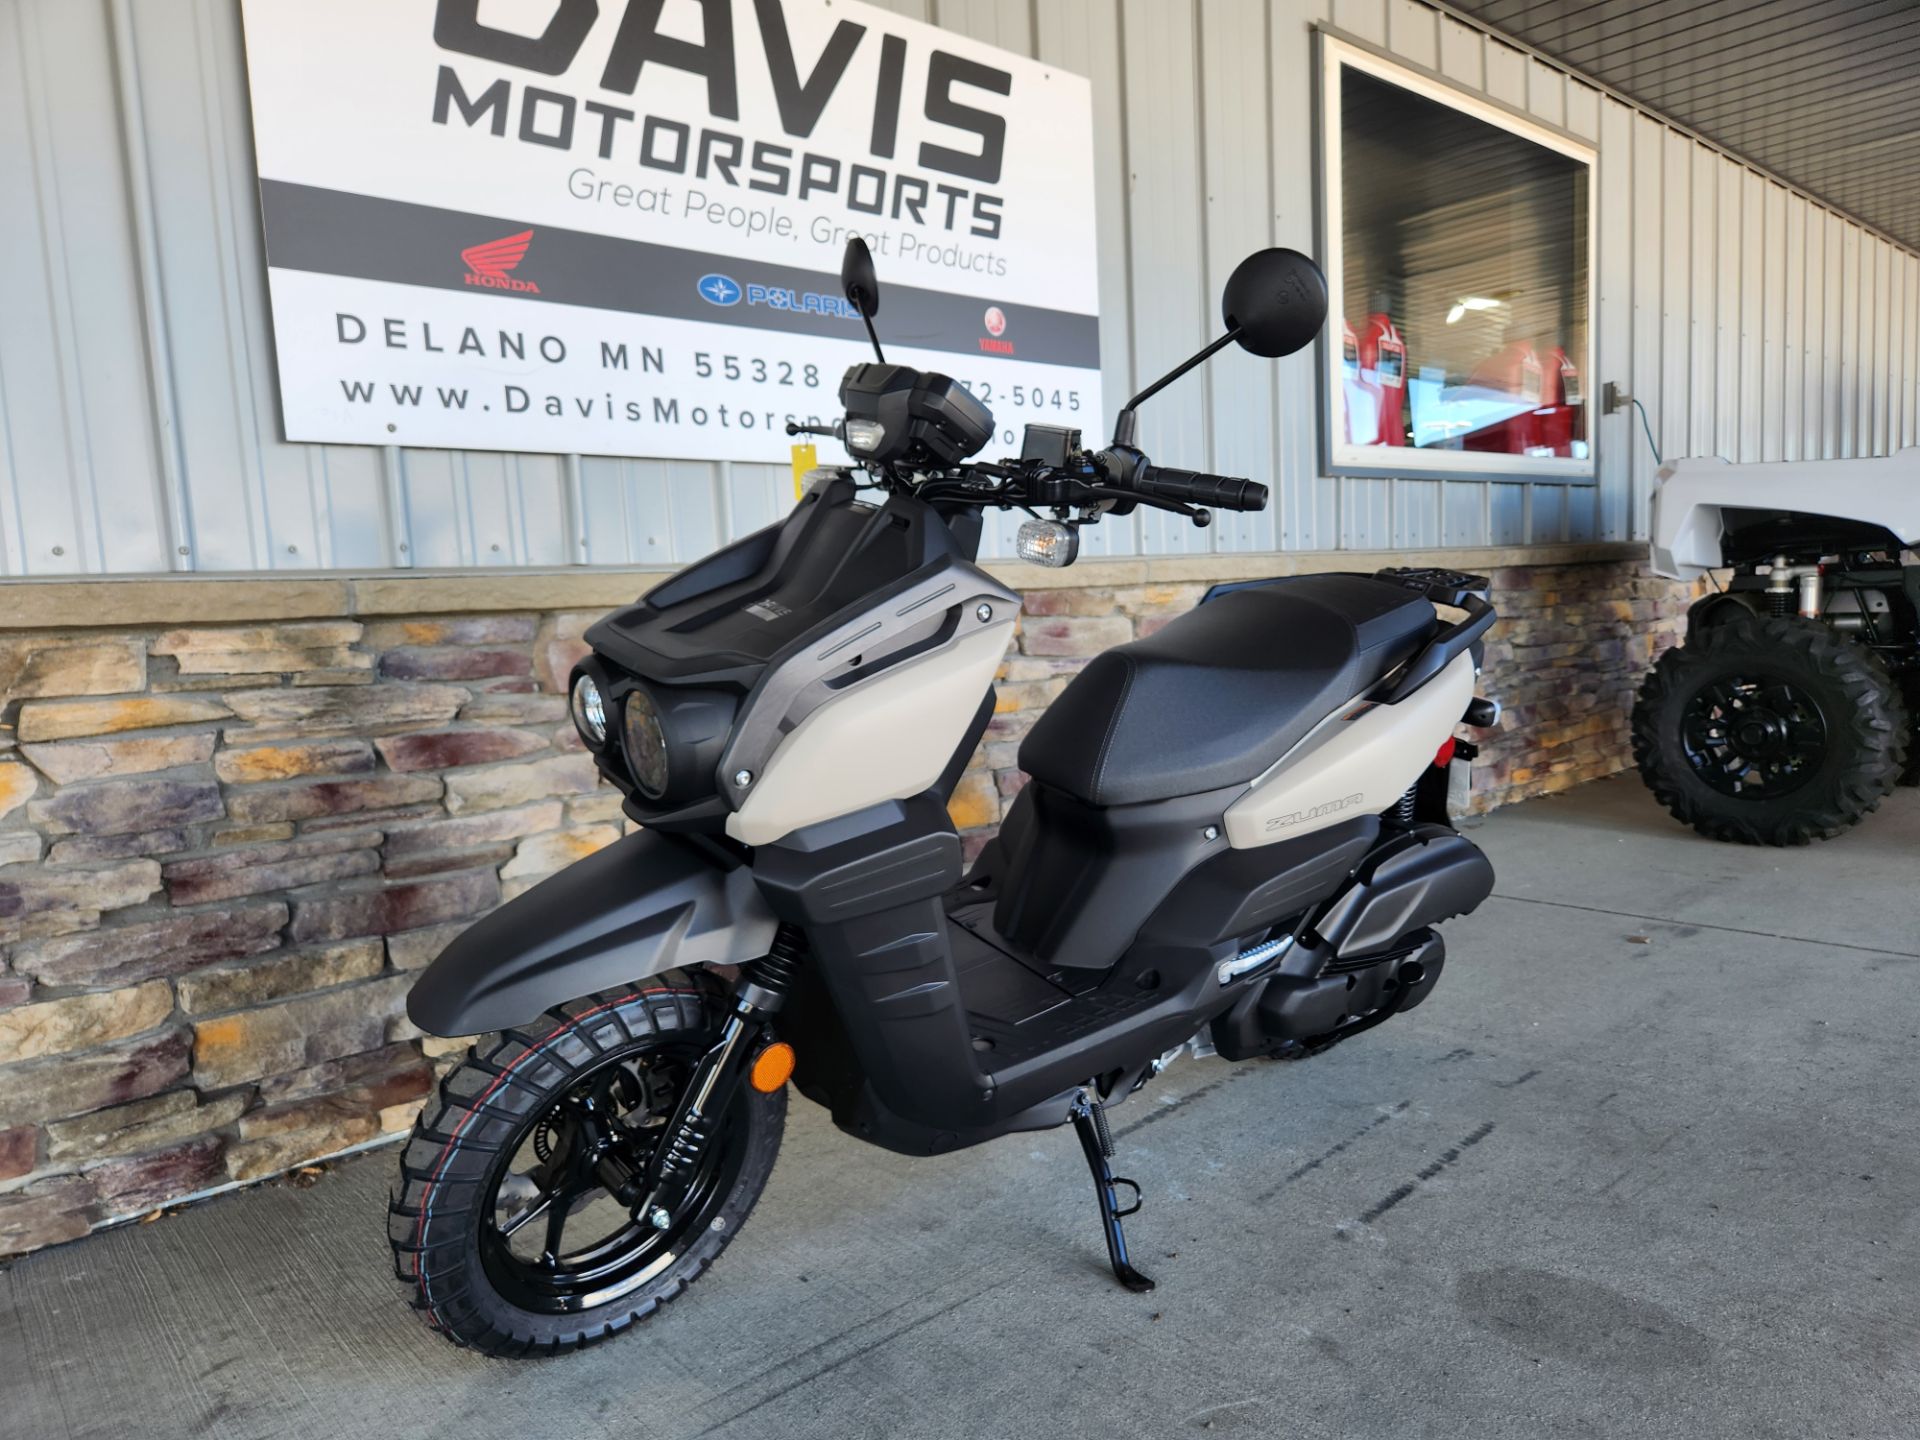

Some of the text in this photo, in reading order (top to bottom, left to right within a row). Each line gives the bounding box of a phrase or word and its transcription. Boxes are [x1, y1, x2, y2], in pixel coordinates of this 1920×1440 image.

[432, 65, 1004, 240] MOTORSPORTS
[567, 168, 673, 215] Great
[684, 190, 798, 241] People,
[899, 233, 1007, 277] Products
[464, 272, 541, 294] HONDA
[336, 313, 1080, 411] DELANO MN 55328 72-5045
[979, 338, 1014, 355] YAMAHA
[1265, 792, 1364, 832] ZUMA
